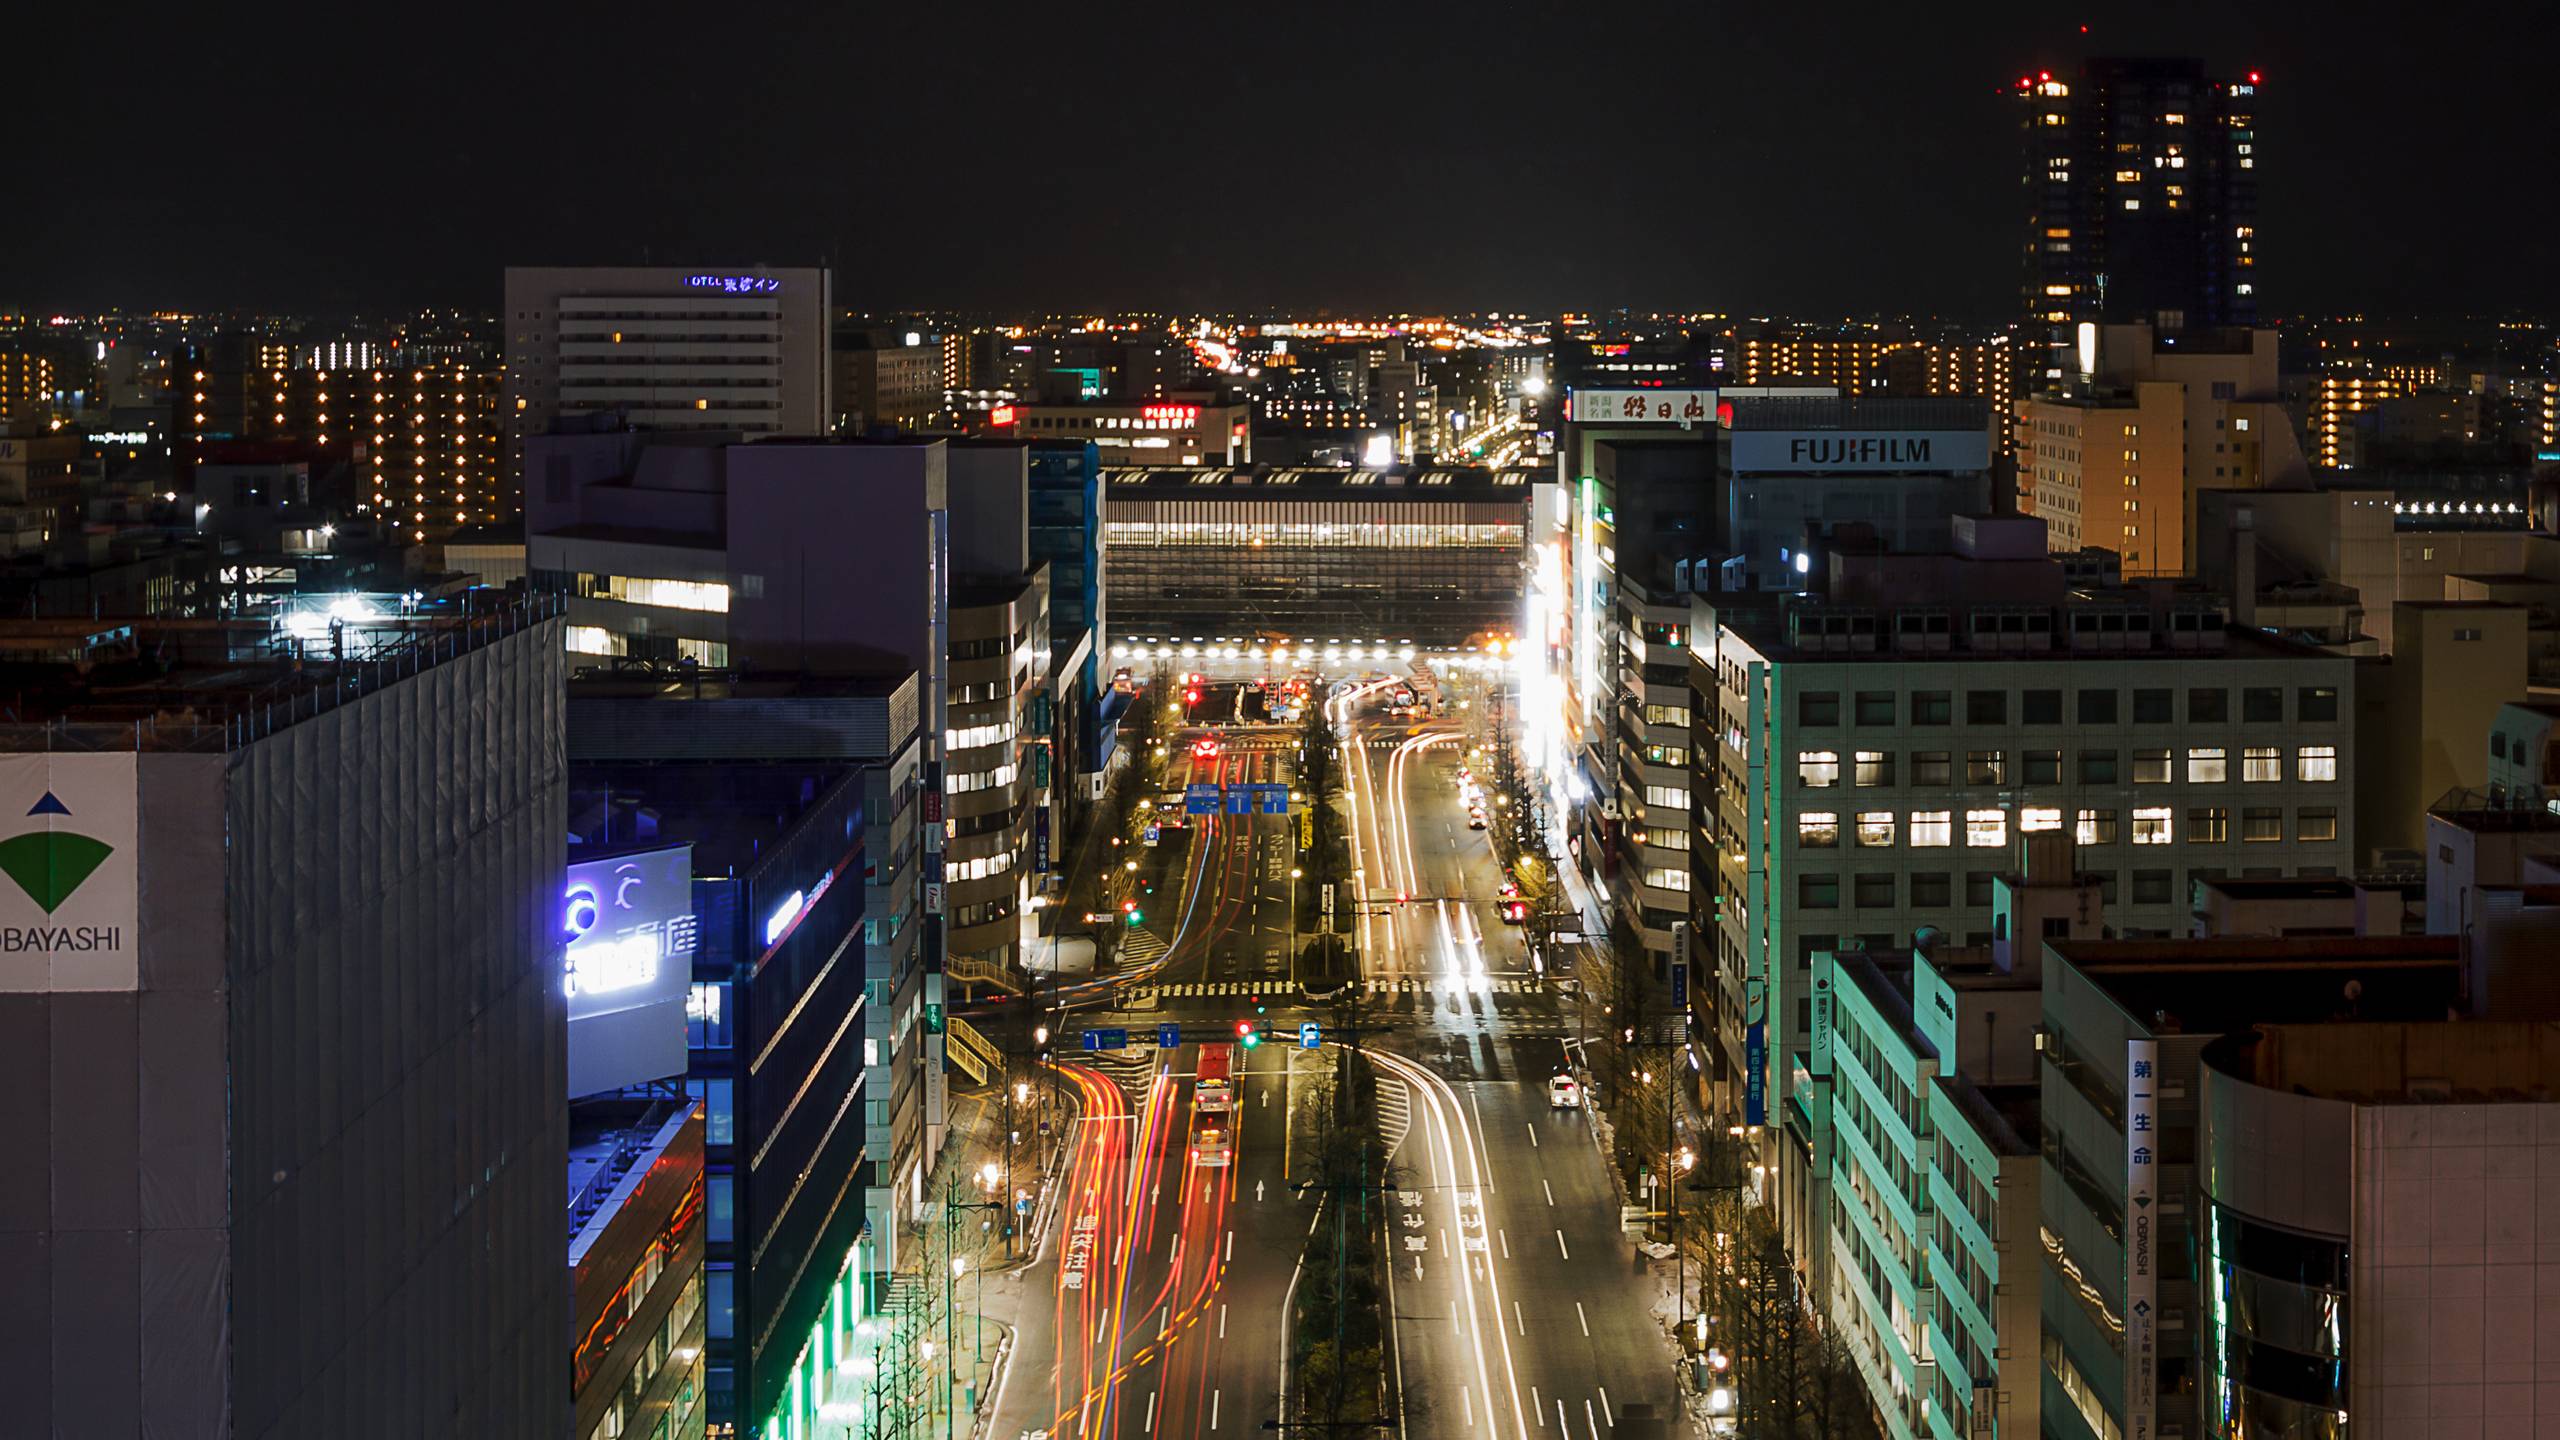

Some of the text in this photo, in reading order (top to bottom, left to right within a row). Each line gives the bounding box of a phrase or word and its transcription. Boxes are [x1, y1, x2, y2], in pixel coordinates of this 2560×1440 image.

[1791, 439, 1931, 463] FUJIFILM
[0, 927, 120, 952] BAYASHI
[2134, 1060, 2152, 1165] 第一生命
[2136, 1216, 2149, 1276] OBAYASHI
